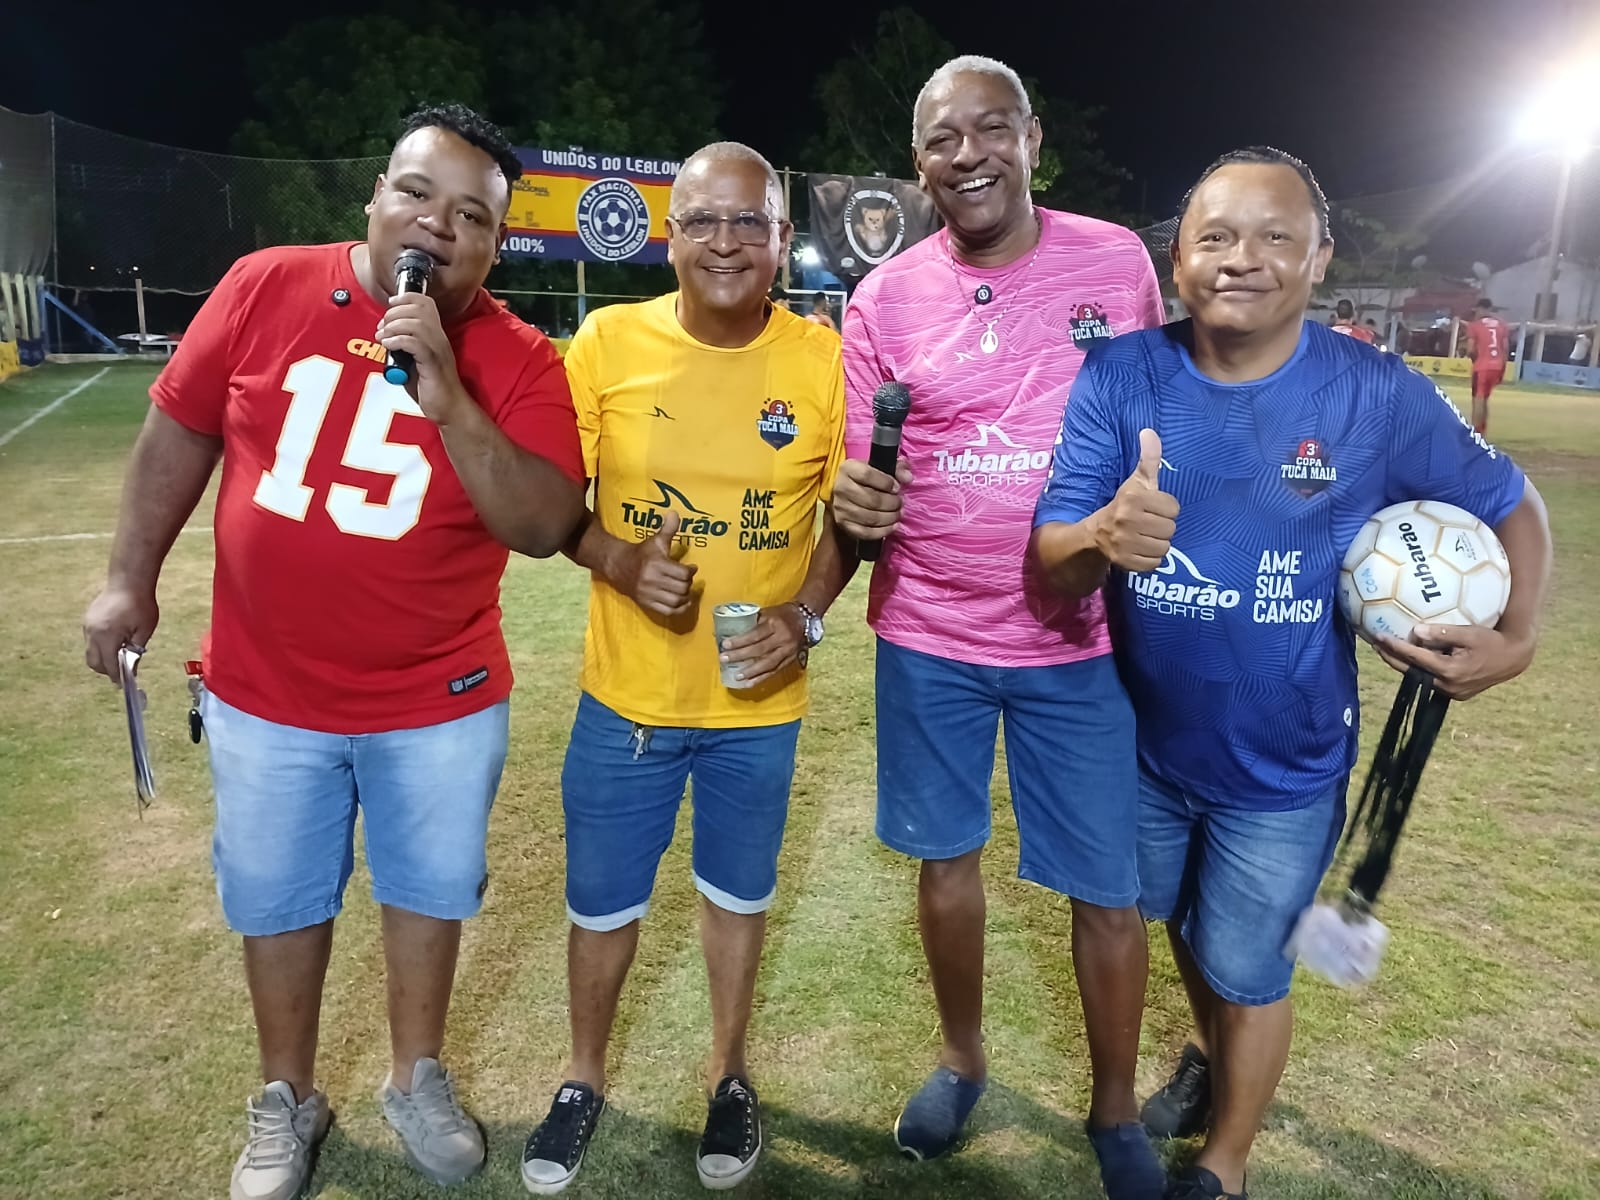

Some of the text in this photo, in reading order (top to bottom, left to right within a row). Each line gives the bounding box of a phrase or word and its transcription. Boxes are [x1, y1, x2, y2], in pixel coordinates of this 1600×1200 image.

[542, 150, 681, 176] UNIDOS DO LEBLON
[582, 182, 644, 211] PAX NACIONAL
[581, 224, 645, 257] UNIDOS DO LEBLON
[1068, 325, 1114, 341] TUCA MAIA
[1079, 319, 1102, 328] COPA
[758, 420, 799, 436] TUCA MAIA
[767, 415, 789, 424] COPA
[253, 354, 433, 541] 15
[933, 448, 1050, 472] Tubarão
[1296, 456, 1322, 467] COPA
[947, 472, 1029, 486] SPORTS
[1281, 464, 1337, 481] TUCA MAIA
[742, 488, 777, 508] AME
[621, 502, 729, 536] Tubrão
[740, 510, 770, 530] SUA
[634, 527, 708, 548] SPRTS
[739, 530, 790, 551] CAMISA
[1258, 550, 1302, 574] AME
[1398, 522, 1442, 603] Tubarão
[1127, 571, 1241, 608] Tubarão
[1255, 576, 1293, 600] SUA
[1136, 594, 1215, 621] SPORTS
[1253, 599, 1323, 624] CAMISA
